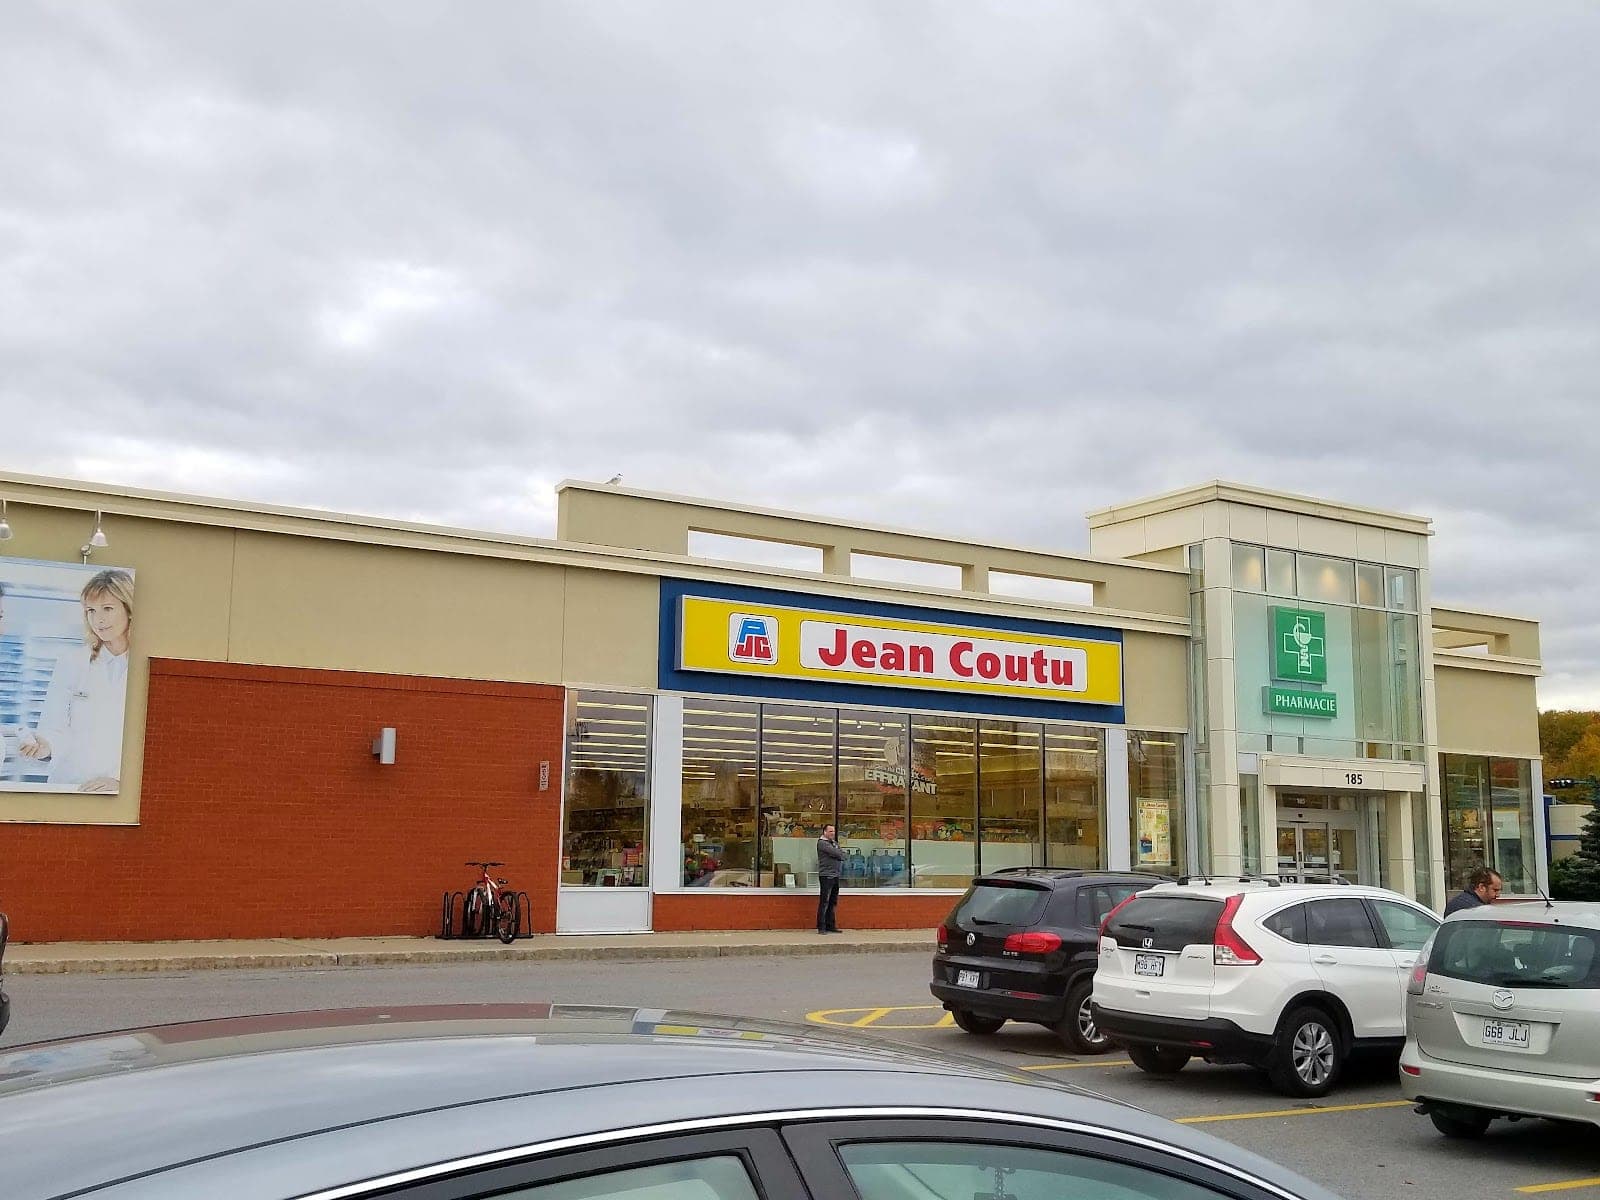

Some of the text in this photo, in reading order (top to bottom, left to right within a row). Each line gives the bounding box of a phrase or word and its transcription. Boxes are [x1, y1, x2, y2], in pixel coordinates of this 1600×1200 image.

[818, 628, 1073, 686] Jean Coutu
[1275, 694, 1336, 711] PHARMACIE
[864, 767, 937, 795] EFFRAANT
[1345, 773, 1363, 785] 185
[1508, 1028, 1528, 1042] JLJ
